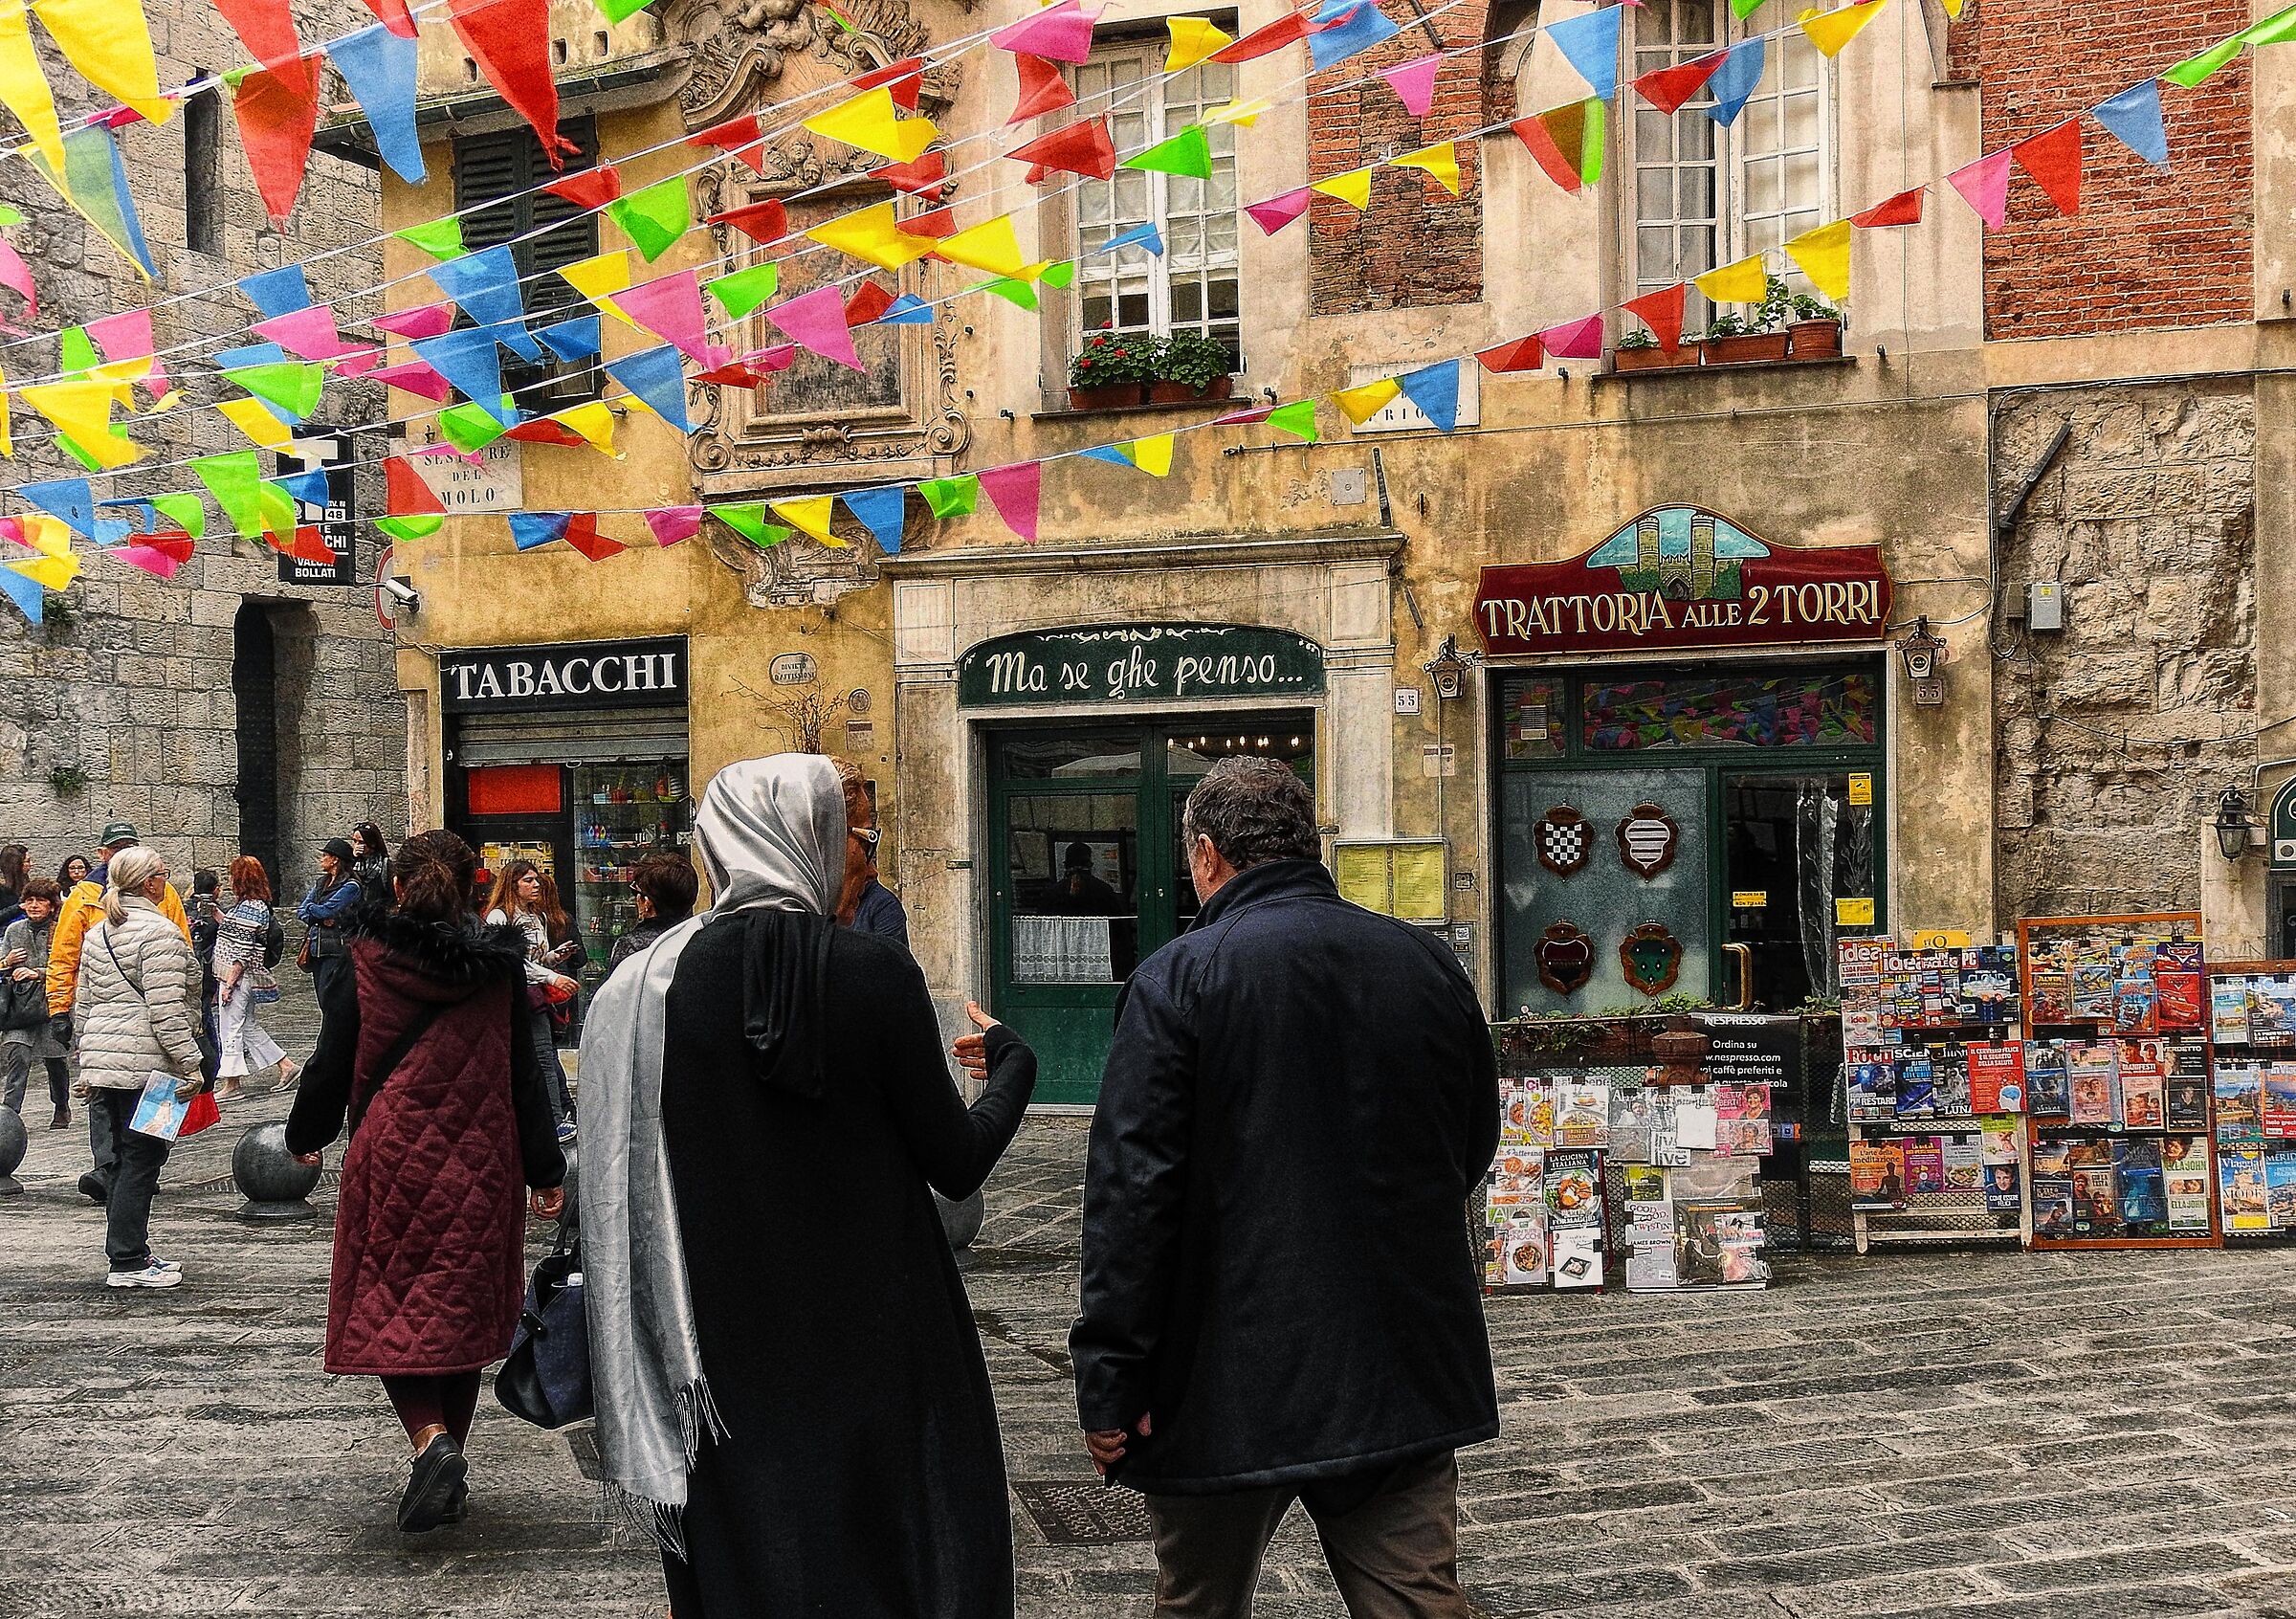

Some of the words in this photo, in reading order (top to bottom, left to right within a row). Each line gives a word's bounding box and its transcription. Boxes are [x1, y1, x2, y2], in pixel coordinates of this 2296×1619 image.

[453, 470, 481, 482] DEL
[441, 487, 496, 506] MOLO
[327, 510, 343, 520] 48
[295, 567, 336, 578] BOLLATI
[1481, 589, 1672, 640] TRATTORIA
[1681, 602, 1743, 629] ALLE
[1748, 585, 1770, 626] 2
[1774, 580, 1882, 625] TORRI
[453, 653, 677, 699] TABACCHI
[986, 651, 1048, 693] Ma
[1058, 661, 1091, 690] se
[1108, 645, 1159, 699] ghe
[1173, 654, 1303, 696] penso...
[1398, 695, 1416, 707] 55
[1962, 952, 1976, 965] PC
[1712, 1040, 1745, 1049] Ordina
[1846, 1048, 1893, 1063] Focu
[1712, 1065, 1735, 1075] caffè
[1737, 1066, 1775, 1076] preferiti
[1655, 1149, 1688, 1165] live
[1552, 1159, 1587, 1168] ITALIANA
